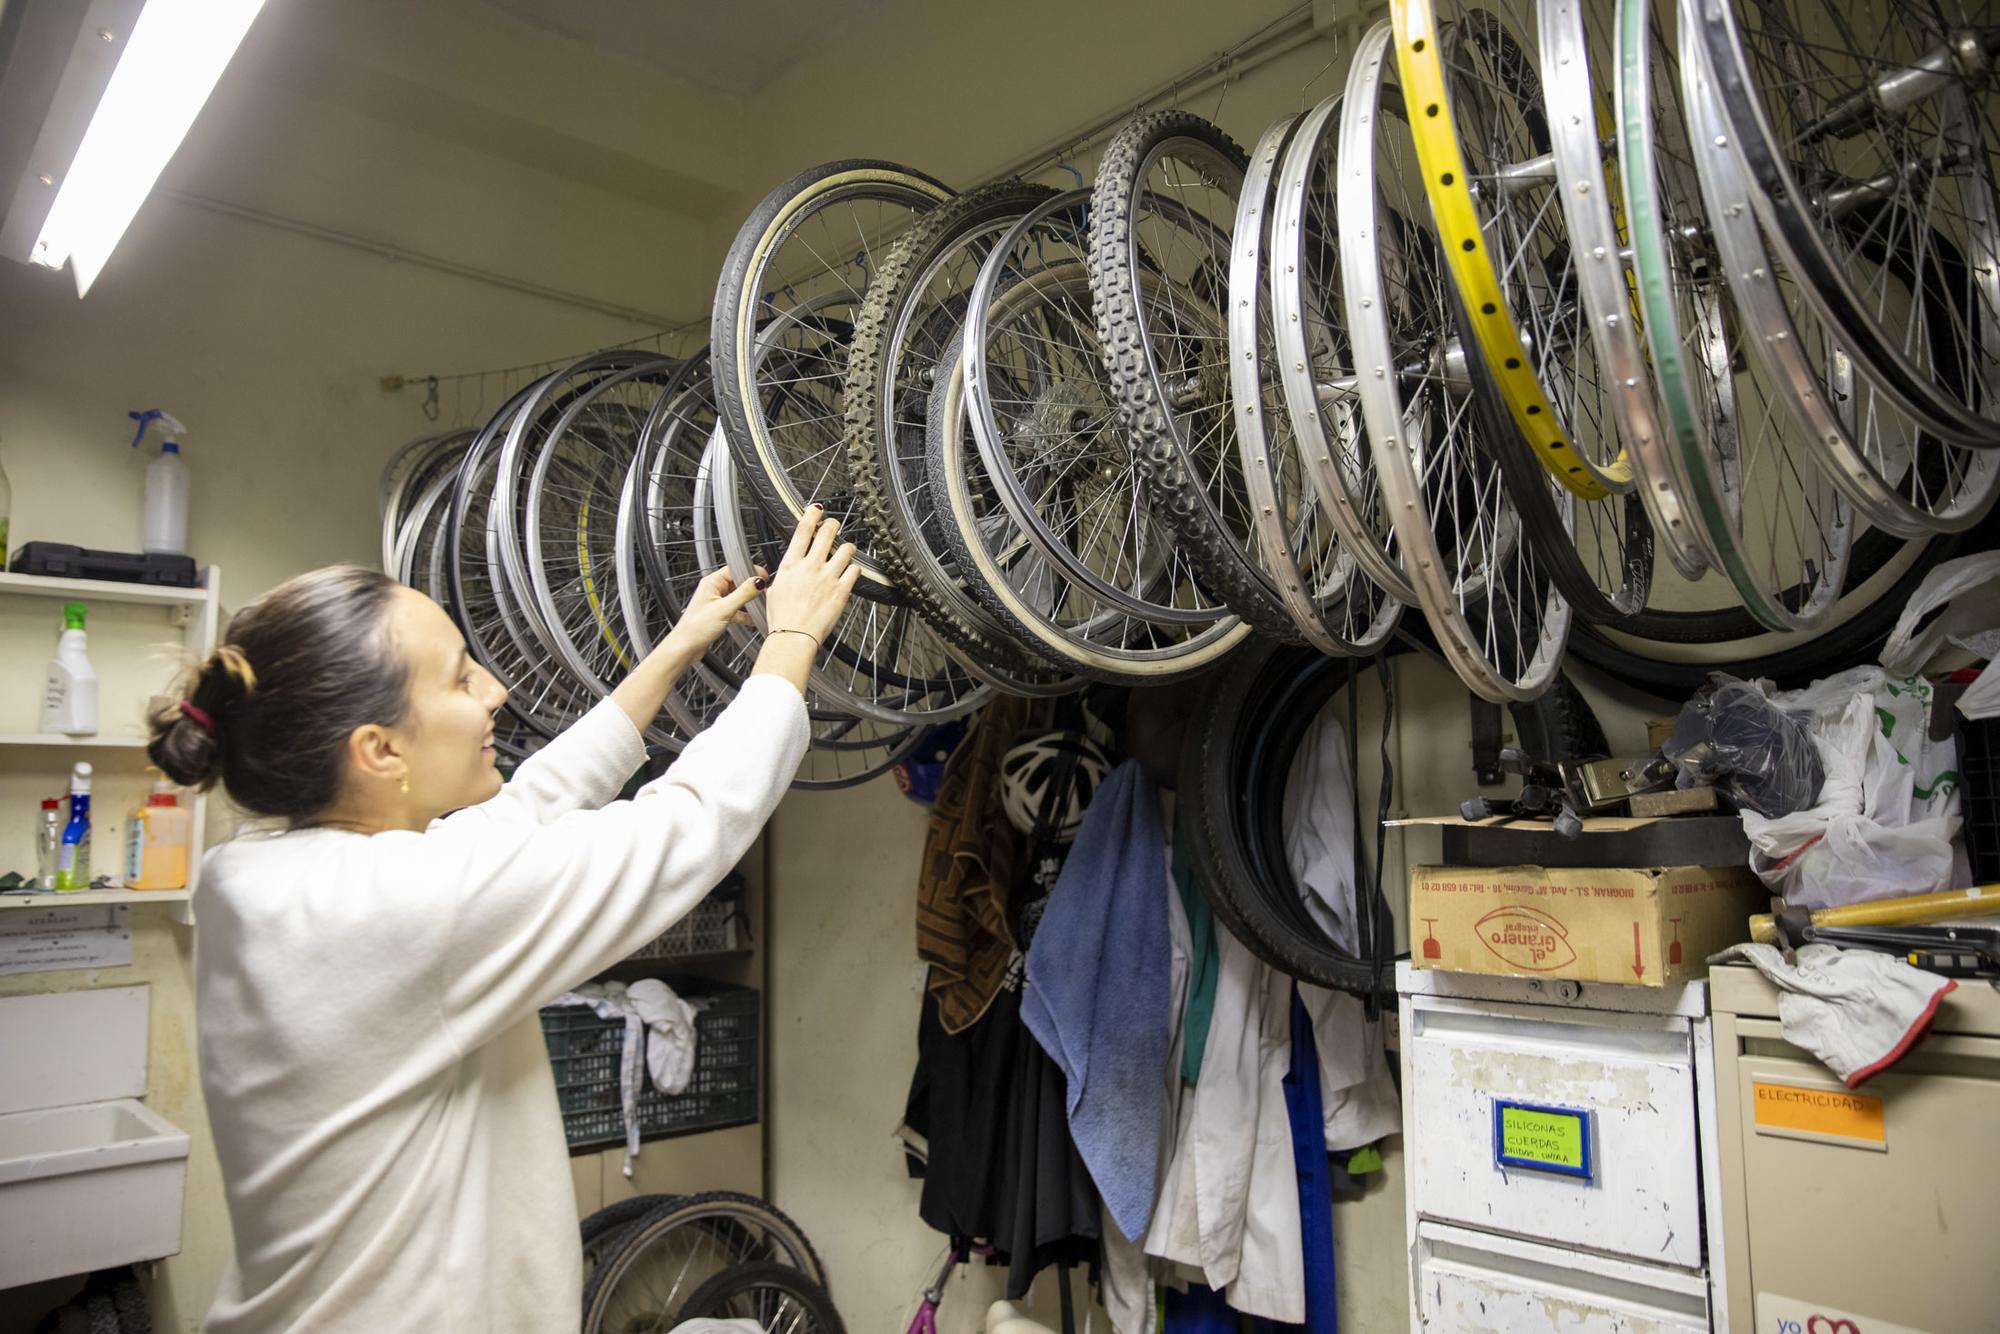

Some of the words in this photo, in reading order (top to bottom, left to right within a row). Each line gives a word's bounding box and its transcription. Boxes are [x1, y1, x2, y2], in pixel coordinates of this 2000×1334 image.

[1491, 932, 1556, 953] Granero
[1758, 1089, 1865, 1111] ELECTRICIDAD
[1504, 1119, 1566, 1137] SILICONAS
[1507, 1136, 1560, 1151] CUERDAS
[1776, 1317, 1802, 1334] yo
